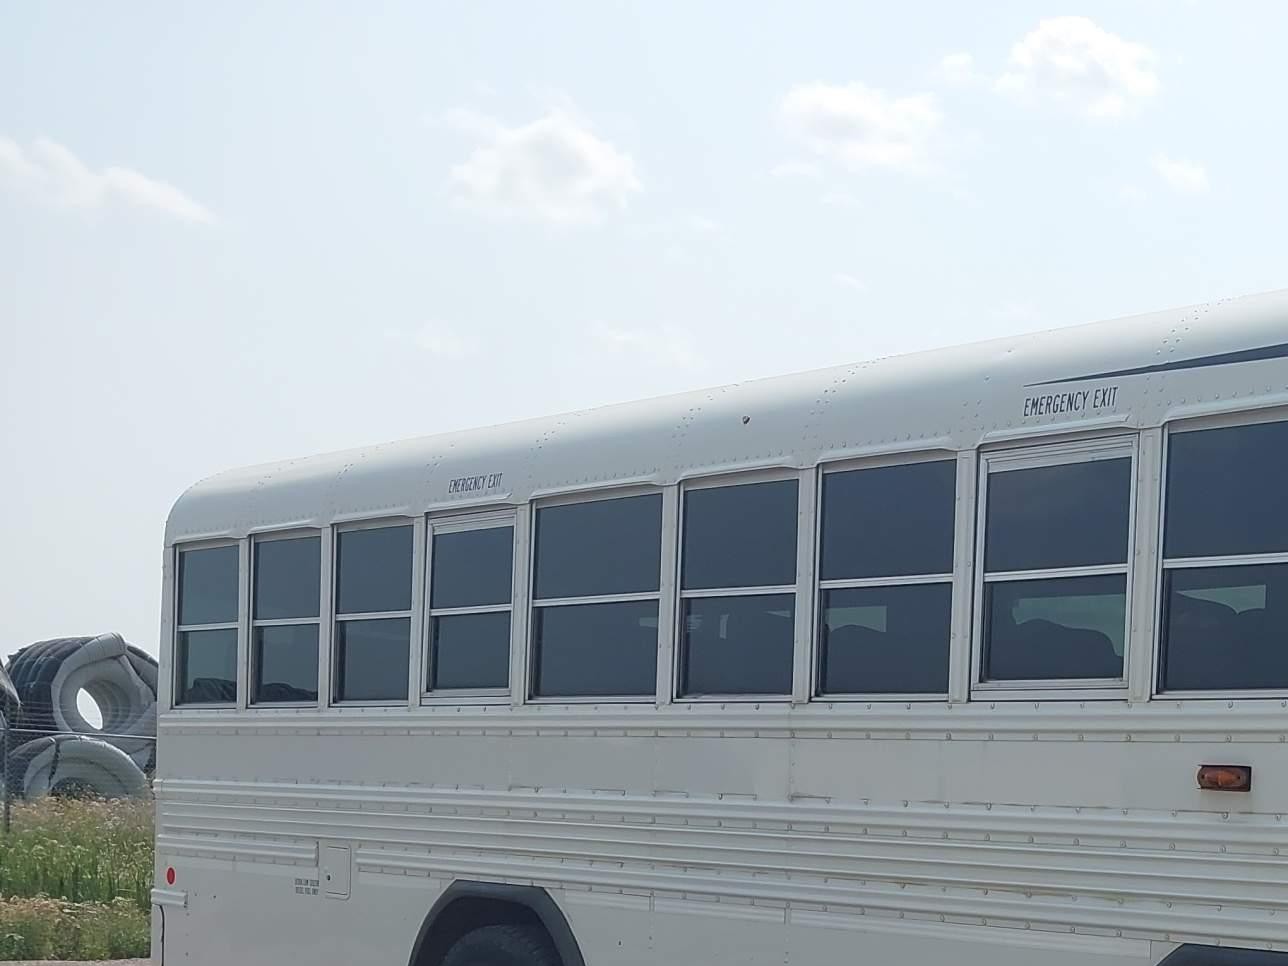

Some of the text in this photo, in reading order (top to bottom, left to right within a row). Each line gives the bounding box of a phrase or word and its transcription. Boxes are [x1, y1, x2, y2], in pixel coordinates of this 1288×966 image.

[1023, 386, 1118, 417] EMERGENCY EXIT
[448, 472, 503, 493] EMERGENCY EXIT
